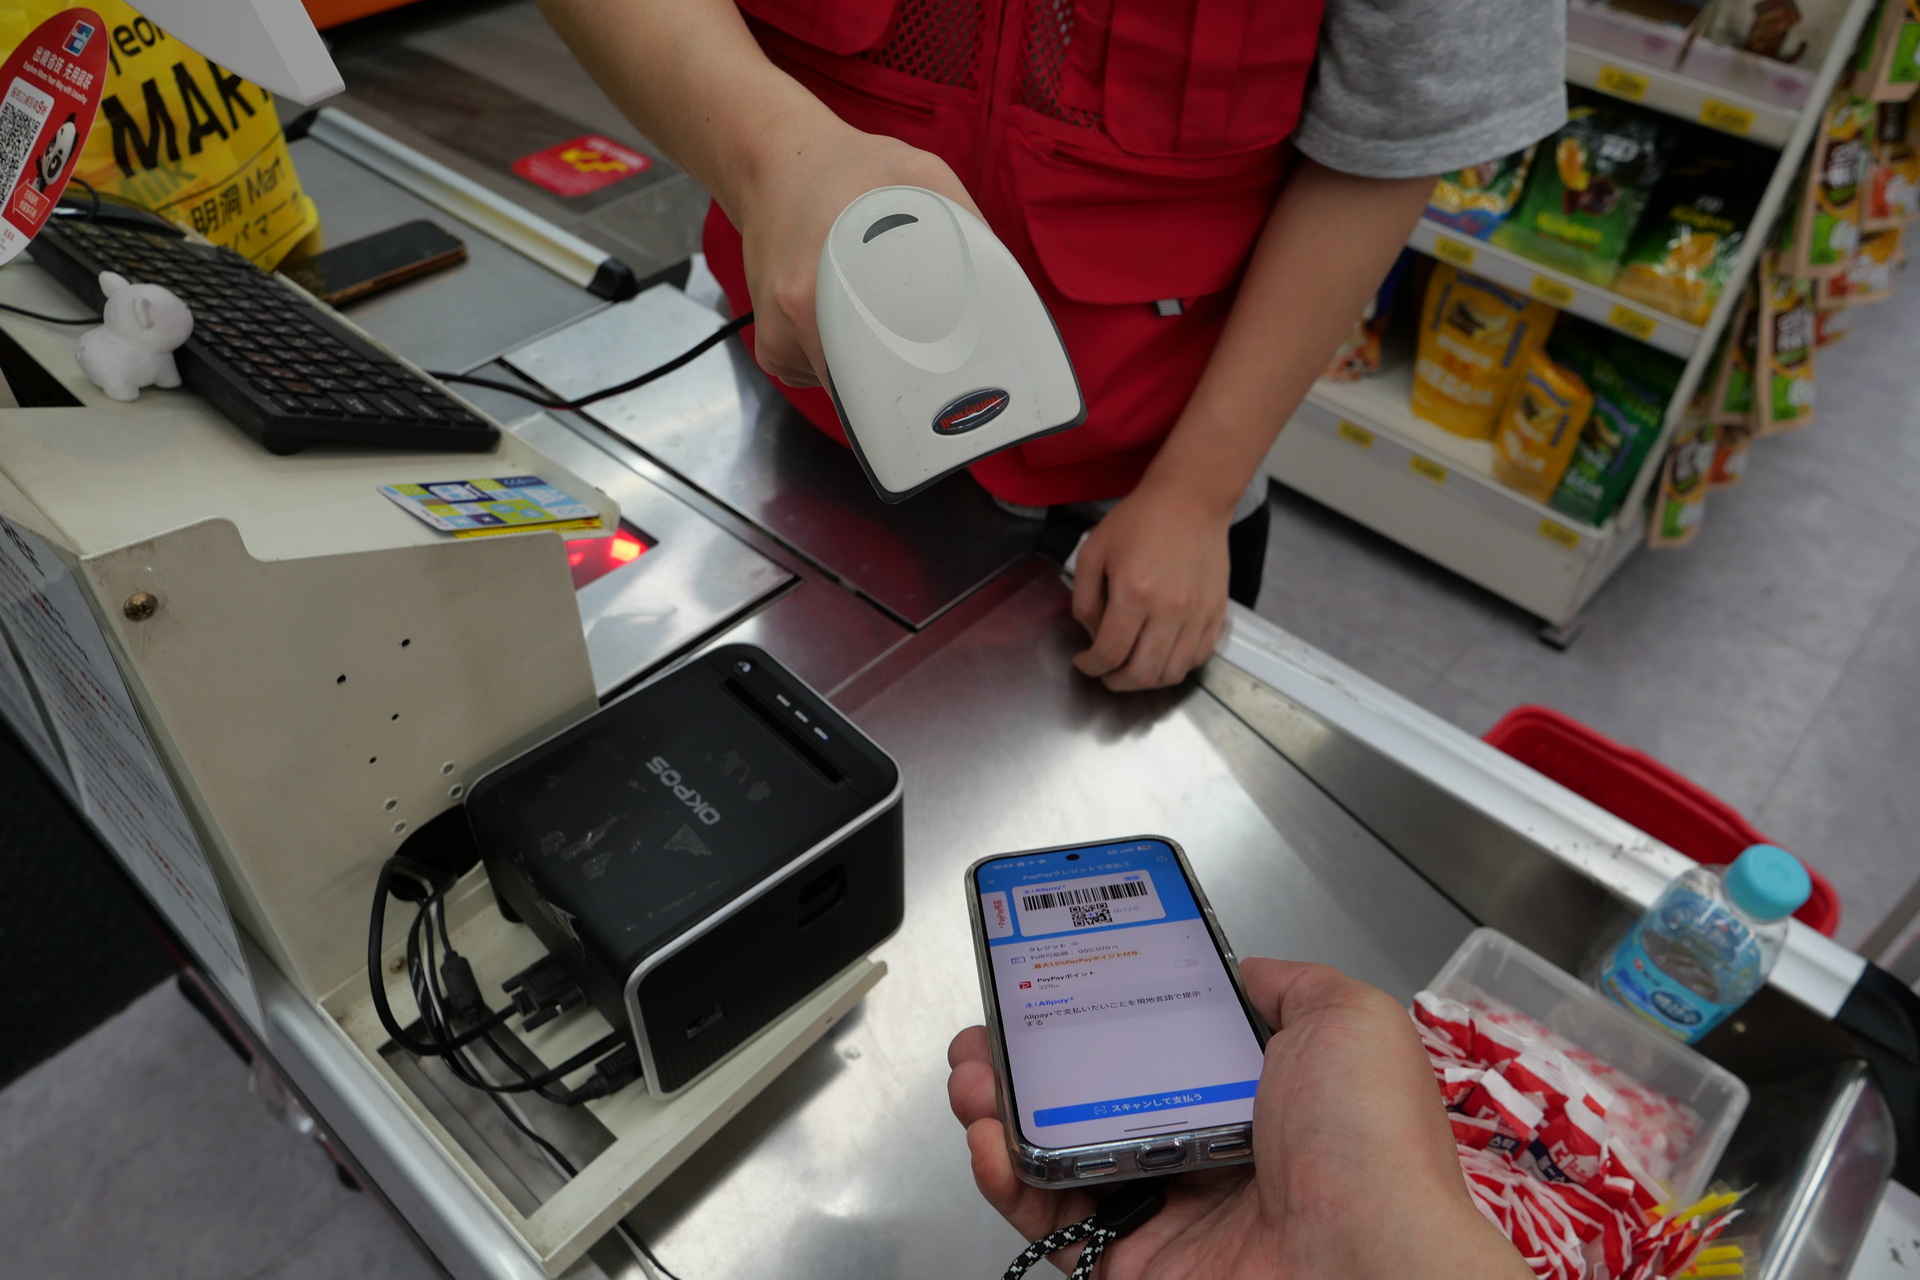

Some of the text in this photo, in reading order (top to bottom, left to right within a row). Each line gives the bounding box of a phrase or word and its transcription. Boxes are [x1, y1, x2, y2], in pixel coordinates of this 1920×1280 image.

[245, 154, 283, 203] Mart
[645, 756, 721, 825] OKPOS
[1037, 969, 1096, 984] PayPayポイント
[1023, 990, 1202, 1021] Alipay+で支払いたいことを現地言語で提示
[1111, 1093, 1203, 1113] スキャンして支払う
